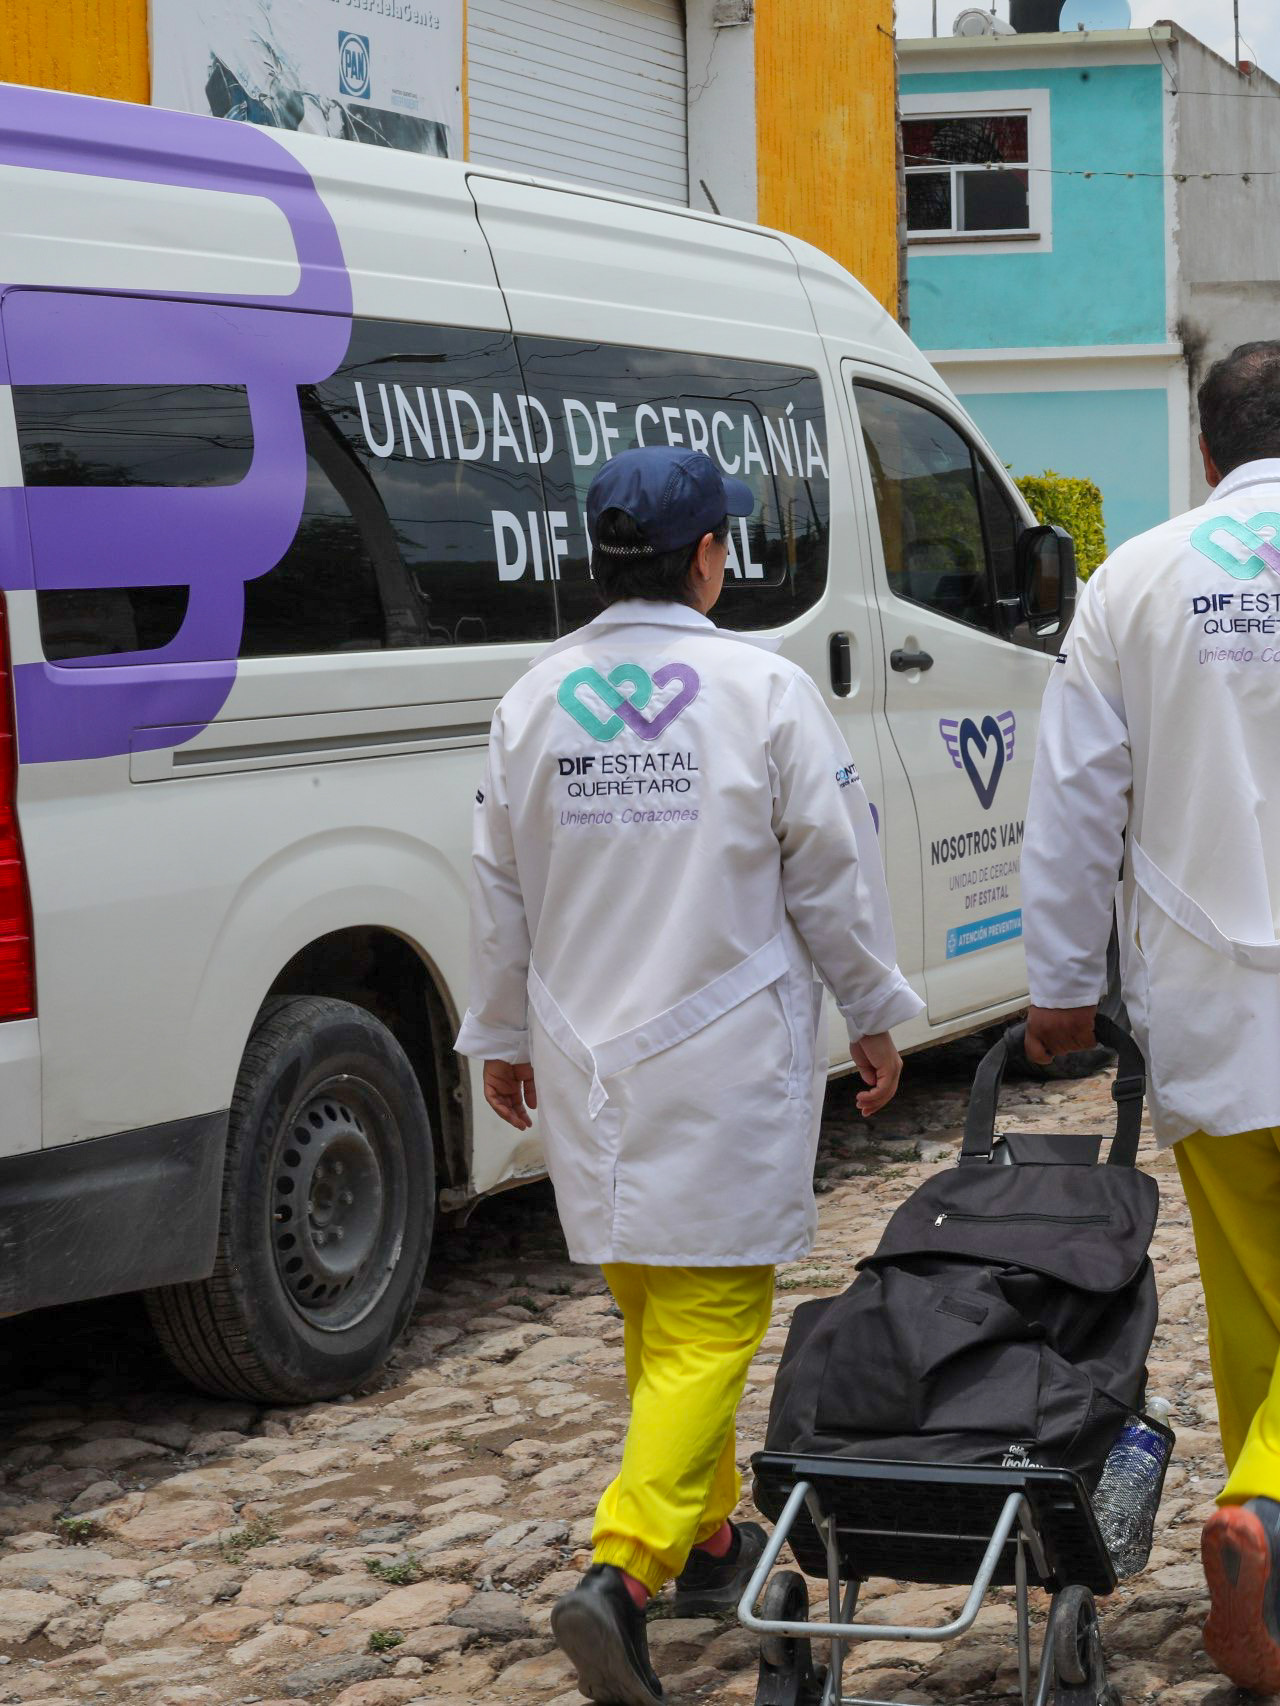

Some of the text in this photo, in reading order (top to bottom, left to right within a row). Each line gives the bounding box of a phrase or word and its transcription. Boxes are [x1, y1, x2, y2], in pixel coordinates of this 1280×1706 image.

[344, 49, 365, 81] PAN
[354, 381, 554, 465] UNIDAD
[491, 510, 569, 581] DIF
[1192, 593, 1234, 615] DIF
[1198, 646, 1254, 665] Uniendo
[558, 751, 699, 777] DIF ESTATAL
[567, 777, 691, 799] QUERÉTARO
[560, 806, 699, 826] Uniendo Corazones
[931, 820, 1025, 866] NOSOTROS VAM
[949, 855, 1021, 891] UNIDAD DE CERCANÍ
[965, 884, 1009, 910] DIF ESTATAL
[958, 925, 988, 947] ATENCIÓN
